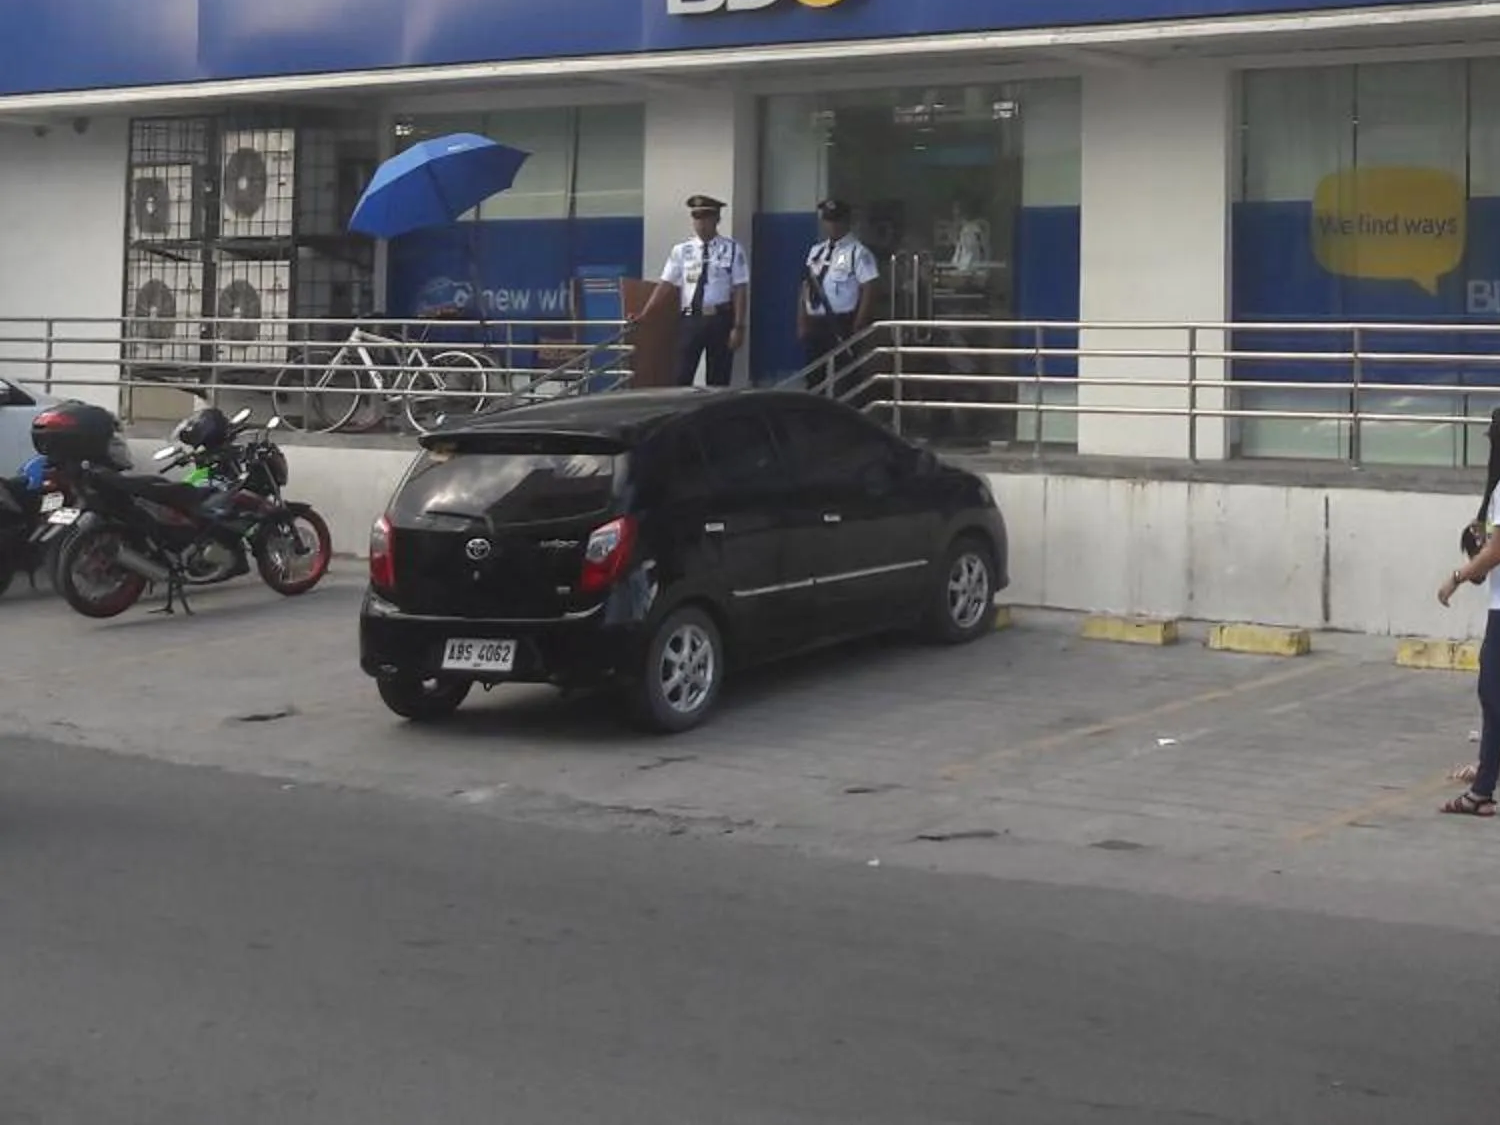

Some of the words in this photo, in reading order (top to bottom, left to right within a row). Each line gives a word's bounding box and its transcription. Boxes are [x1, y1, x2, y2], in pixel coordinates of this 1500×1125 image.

[1317, 213, 1352, 236] We
[1402, 217, 1458, 240] ways
[481, 286, 531, 312] new
